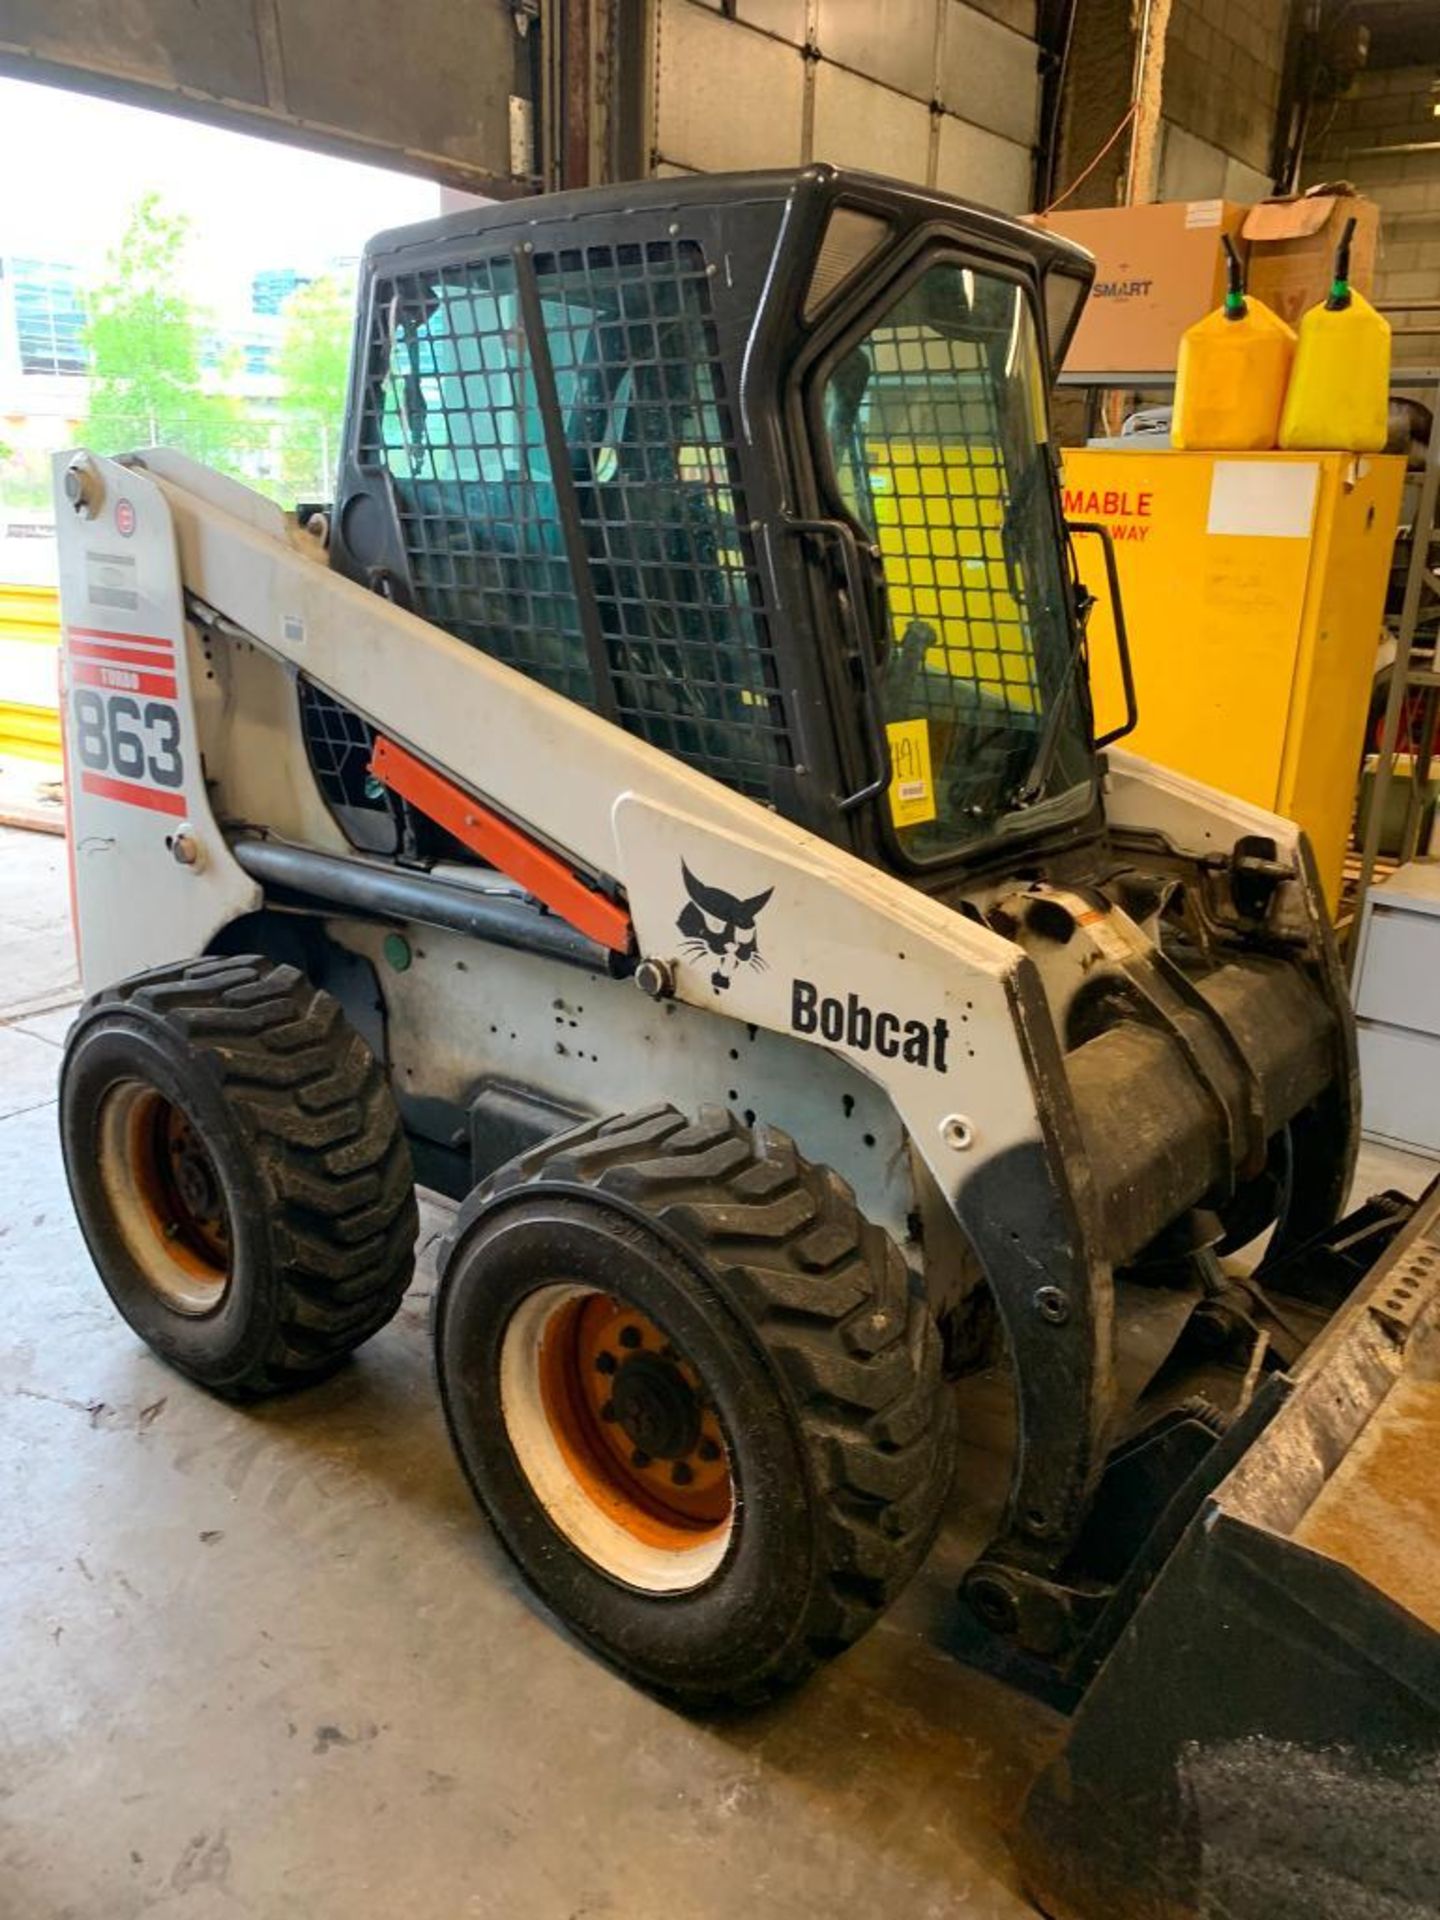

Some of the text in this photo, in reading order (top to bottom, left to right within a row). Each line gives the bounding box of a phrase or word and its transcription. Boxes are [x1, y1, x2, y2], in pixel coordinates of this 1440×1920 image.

[1093, 281, 1152, 298] SMART
[1063, 490, 1153, 516] MABLE
[1110, 524, 1150, 541] WAY
[74, 688, 184, 788] 863
[791, 978, 949, 1074] Bobcat
